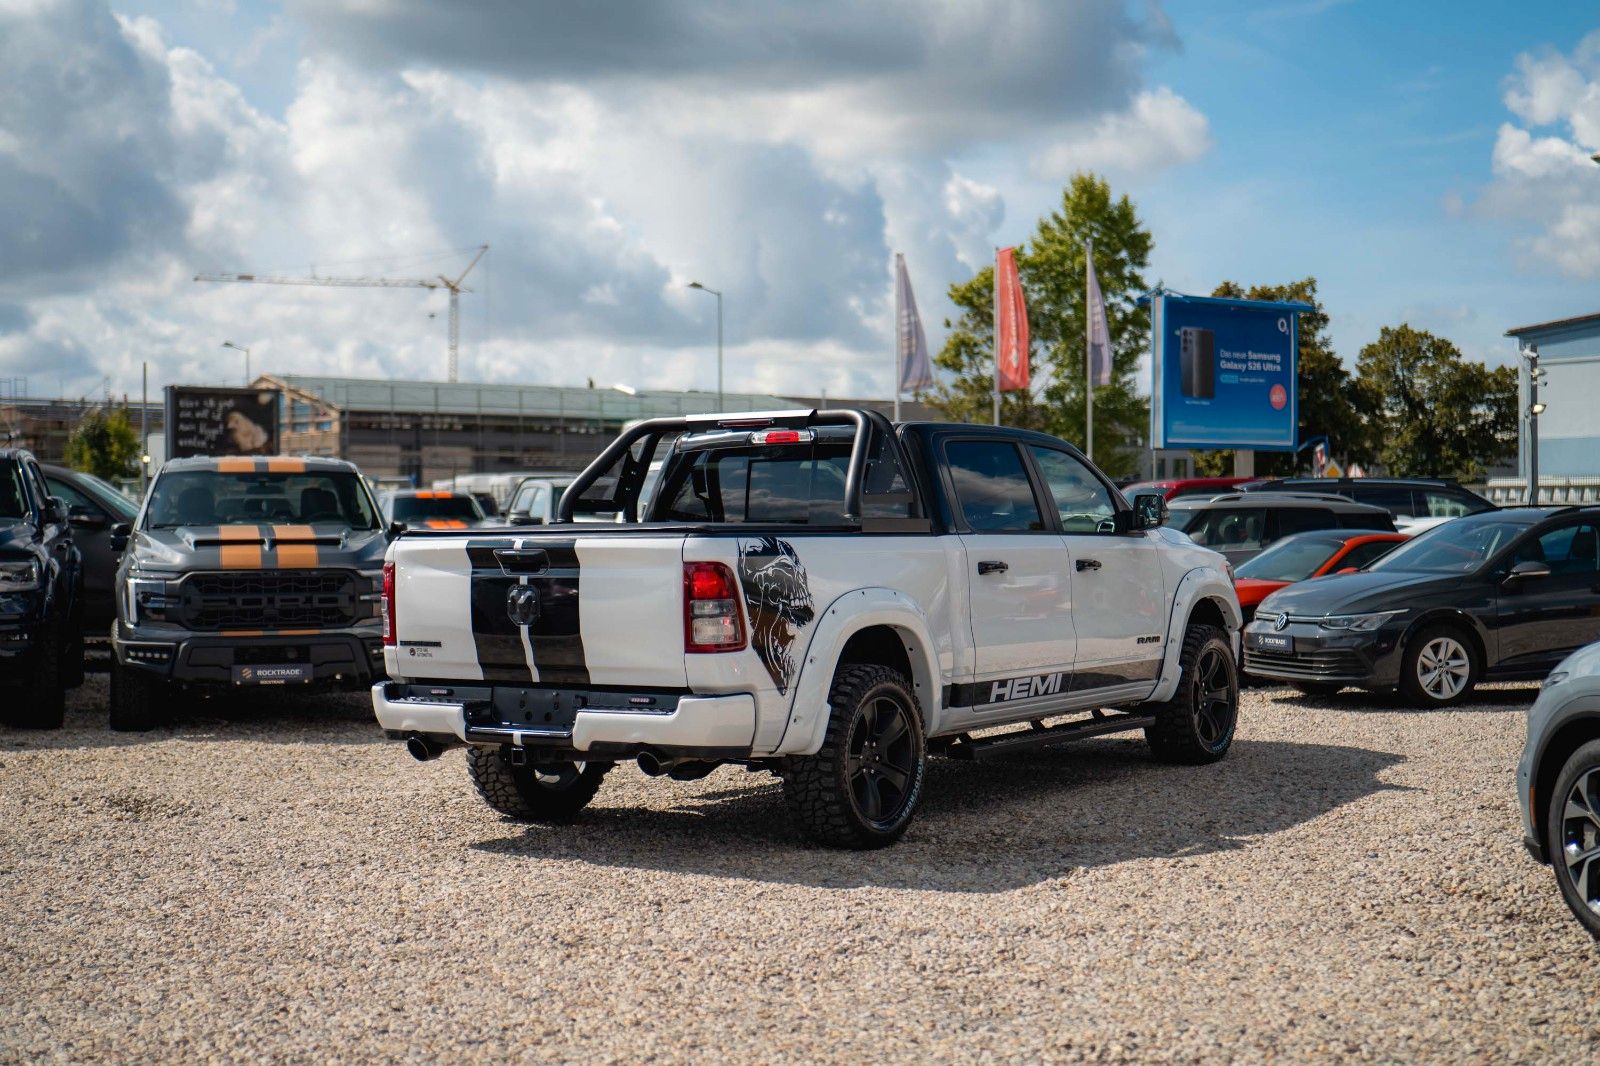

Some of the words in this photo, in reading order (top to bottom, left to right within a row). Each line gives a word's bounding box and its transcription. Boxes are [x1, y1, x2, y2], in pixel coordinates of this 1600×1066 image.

[1247, 350, 1281, 364] Samsung
[1220, 360, 1246, 372] Galaxy
[1263, 362, 1281, 372] Ultra
[1136, 635, 1161, 645] RAM
[256, 668, 301, 677] ROCKTRADE
[989, 672, 1063, 703] HEMI
